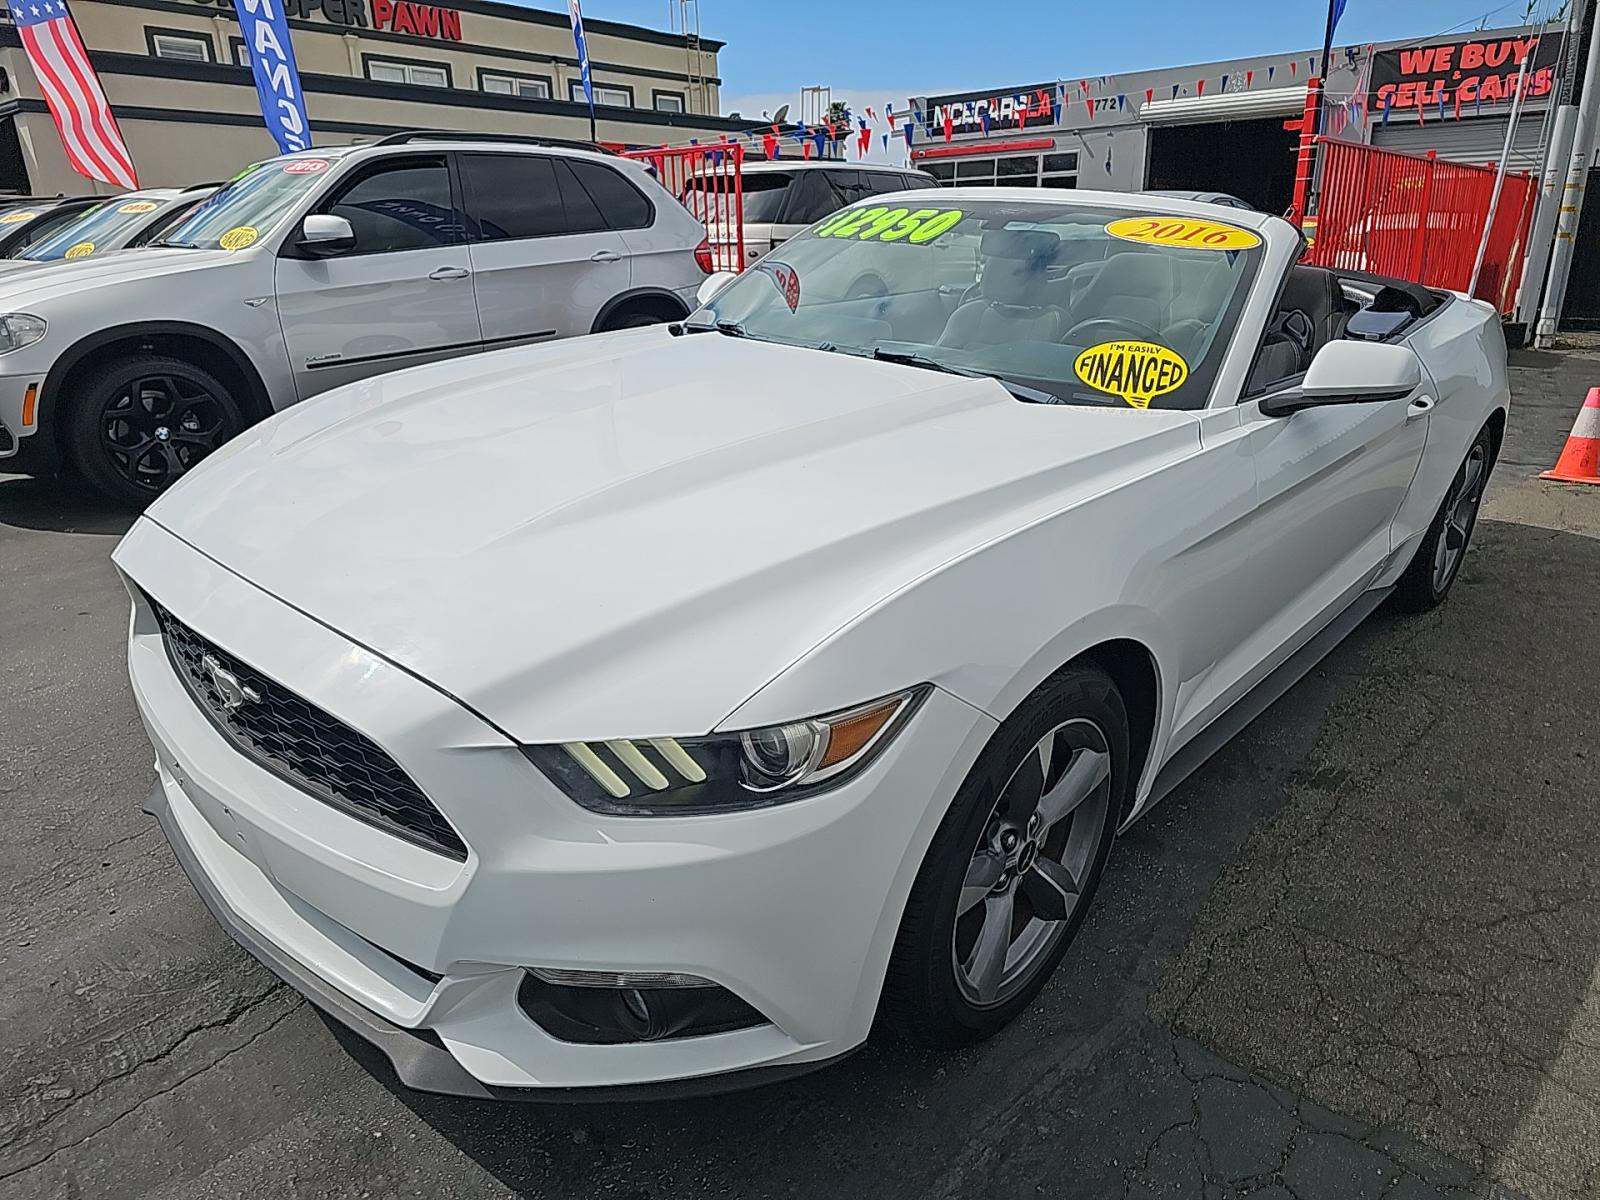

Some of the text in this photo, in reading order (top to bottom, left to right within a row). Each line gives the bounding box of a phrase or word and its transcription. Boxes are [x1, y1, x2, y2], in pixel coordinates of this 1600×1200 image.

[371, 0, 463, 41] PAWN
[1400, 46, 1455, 76] WE
[1459, 38, 1540, 70] BUY
[1375, 79, 1450, 110] SELL
[1458, 68, 1553, 102] CARS
[1452, 70, 1462, 80] &
[1095, 97, 1117, 111] 772
[1125, 221, 1238, 244] 2016
[1109, 343, 1162, 355] I'M EASILY
[1079, 352, 1184, 394] FINANCED
